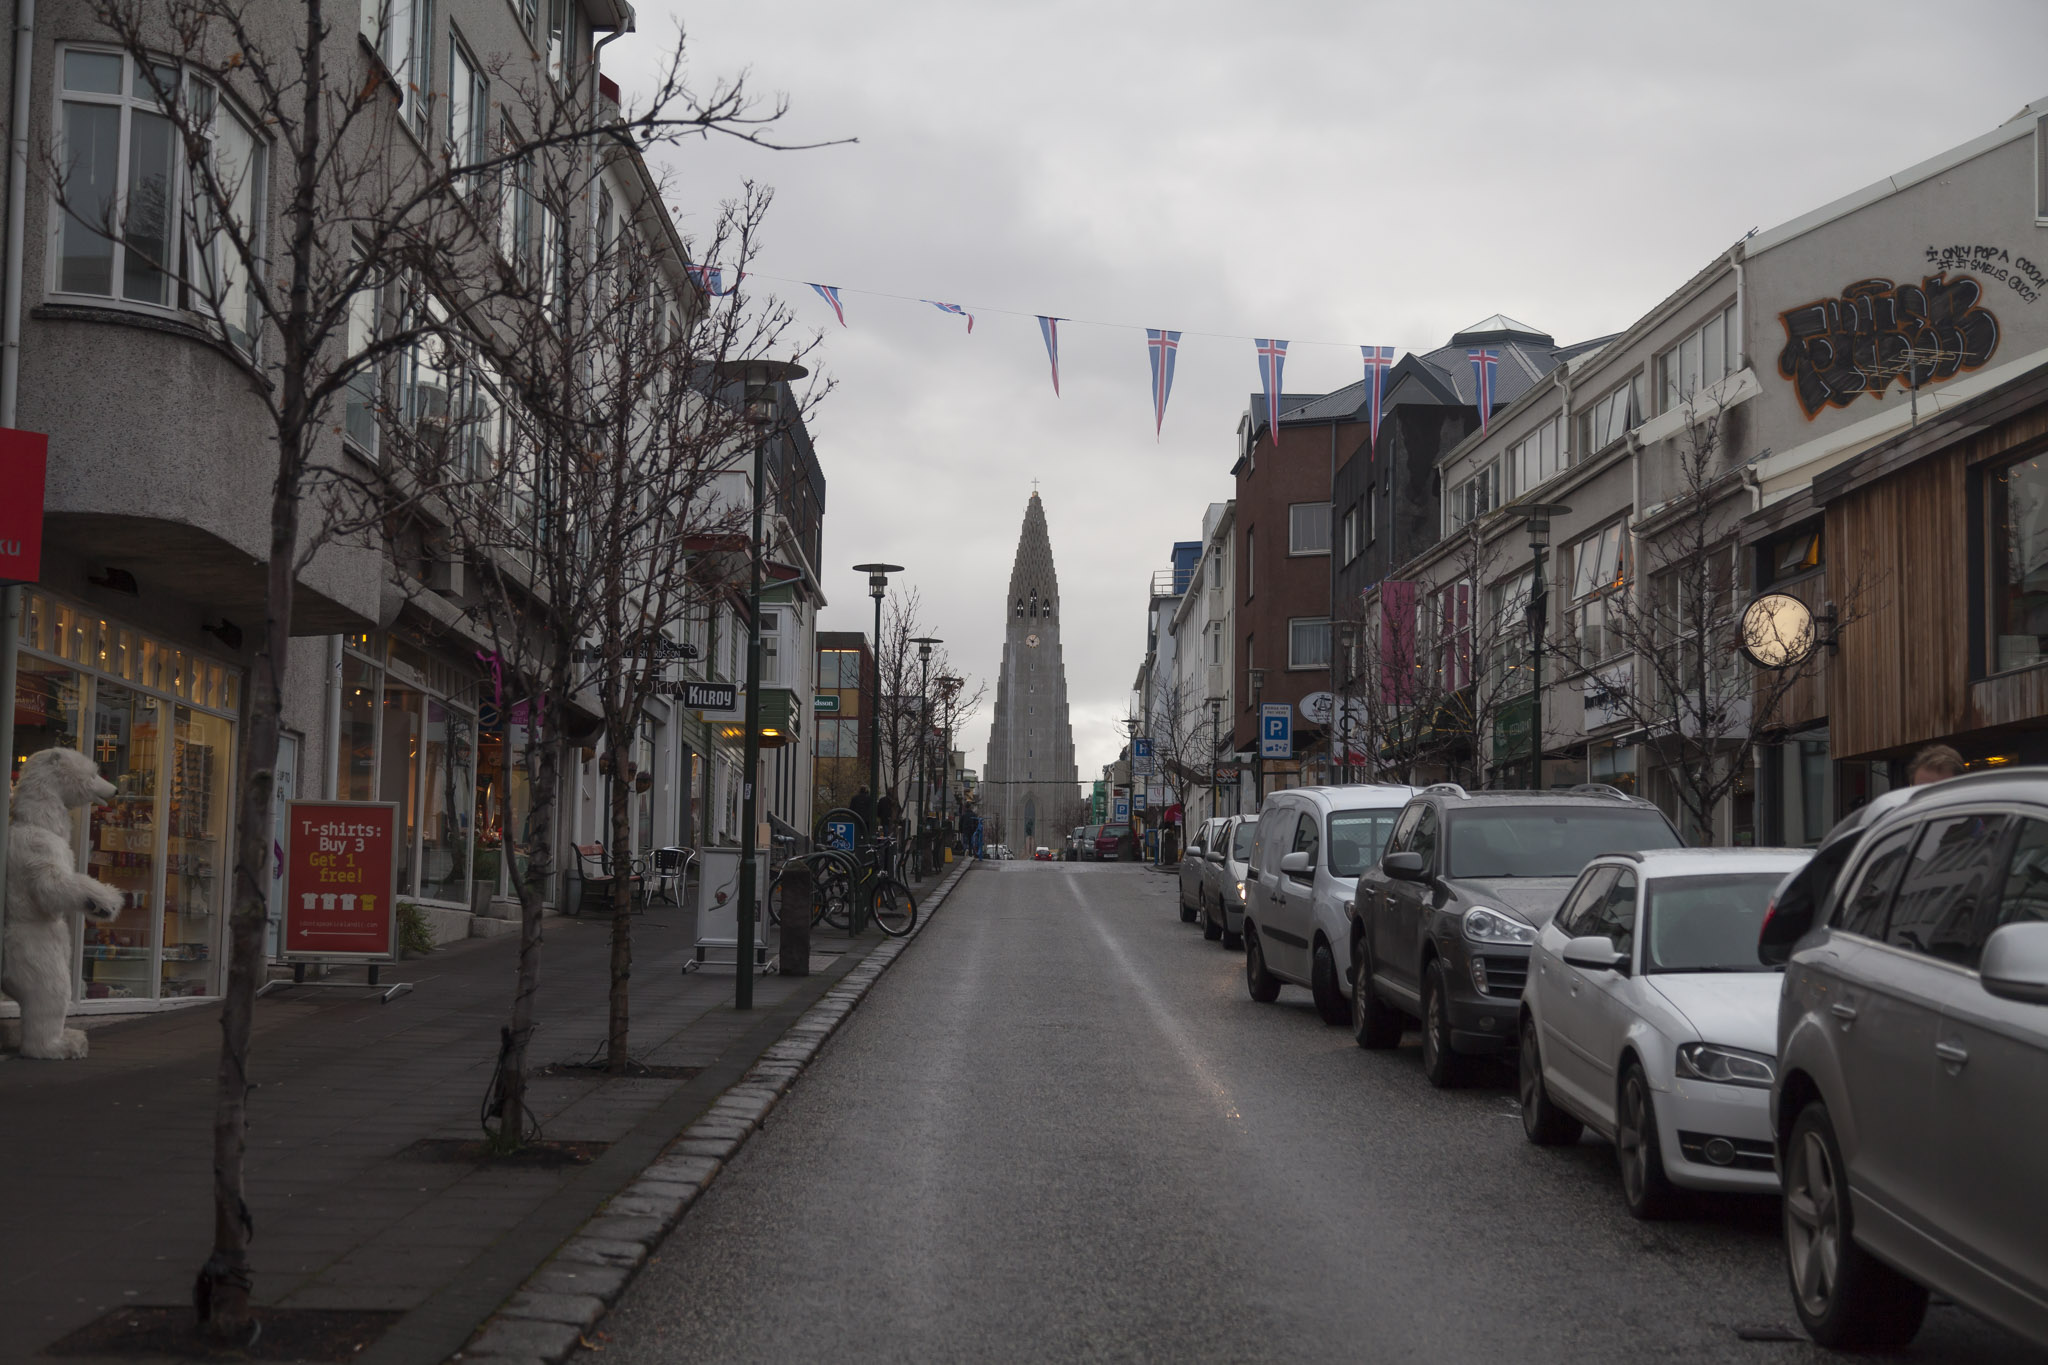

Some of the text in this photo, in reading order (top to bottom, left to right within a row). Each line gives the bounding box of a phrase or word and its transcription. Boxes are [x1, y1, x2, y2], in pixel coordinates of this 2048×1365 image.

[1942, 245, 1971, 259] ONLY
[1974, 246, 1998, 260] POP
[1998, 249, 2009, 263] A
[1937, 259, 1954, 270] IF
[1970, 259, 2009, 281] SMELLS
[2008, 276, 2042, 304] GUCCI
[302, 821, 382, 837] T-shirts:
[836, 824, 847, 836] P
[320, 837, 365, 855] Buy 3
[309, 852, 356, 867] Get 1
[319, 867, 363, 883] free!
